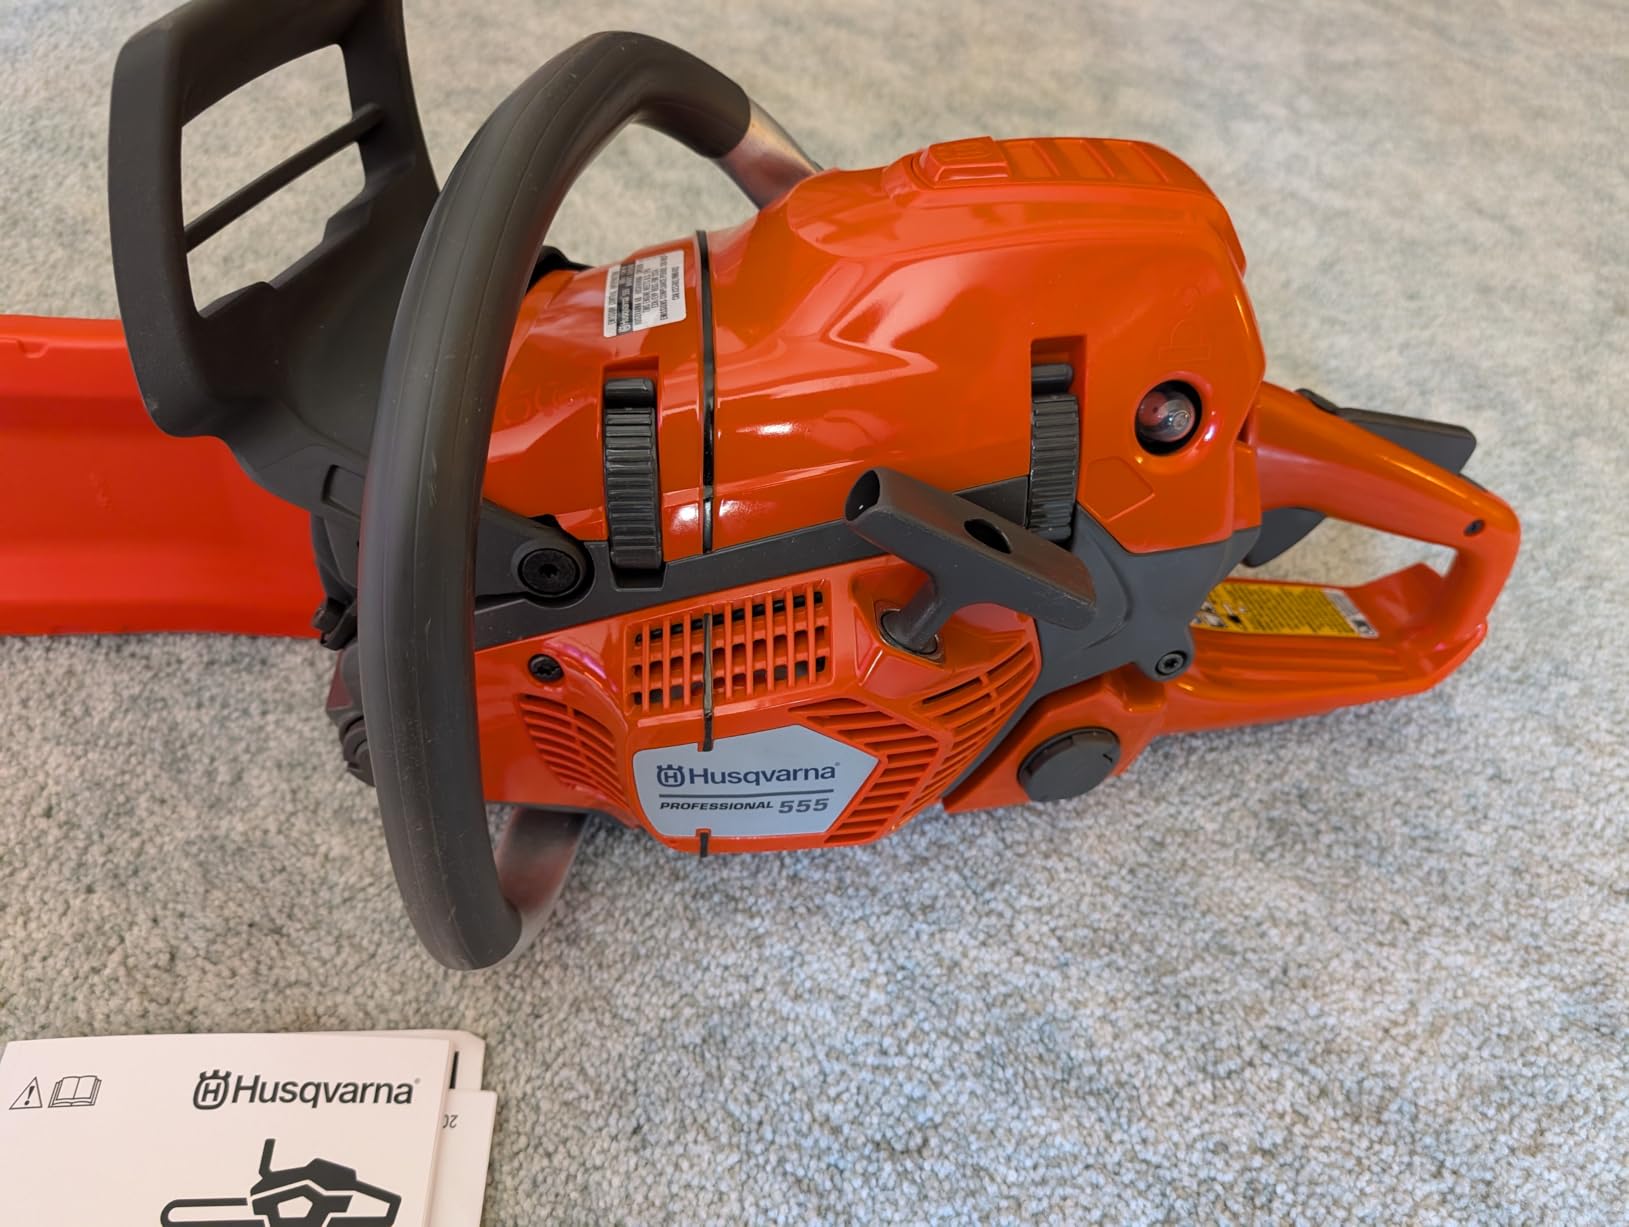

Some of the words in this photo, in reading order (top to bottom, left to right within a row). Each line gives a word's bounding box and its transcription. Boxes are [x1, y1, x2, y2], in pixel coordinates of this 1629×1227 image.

[689, 766, 836, 786] Husqvarna
[659, 801, 774, 811] PROFESSIONAL
[778, 798, 830, 814] 555
[231, 1074, 414, 1108] Husqvarna
